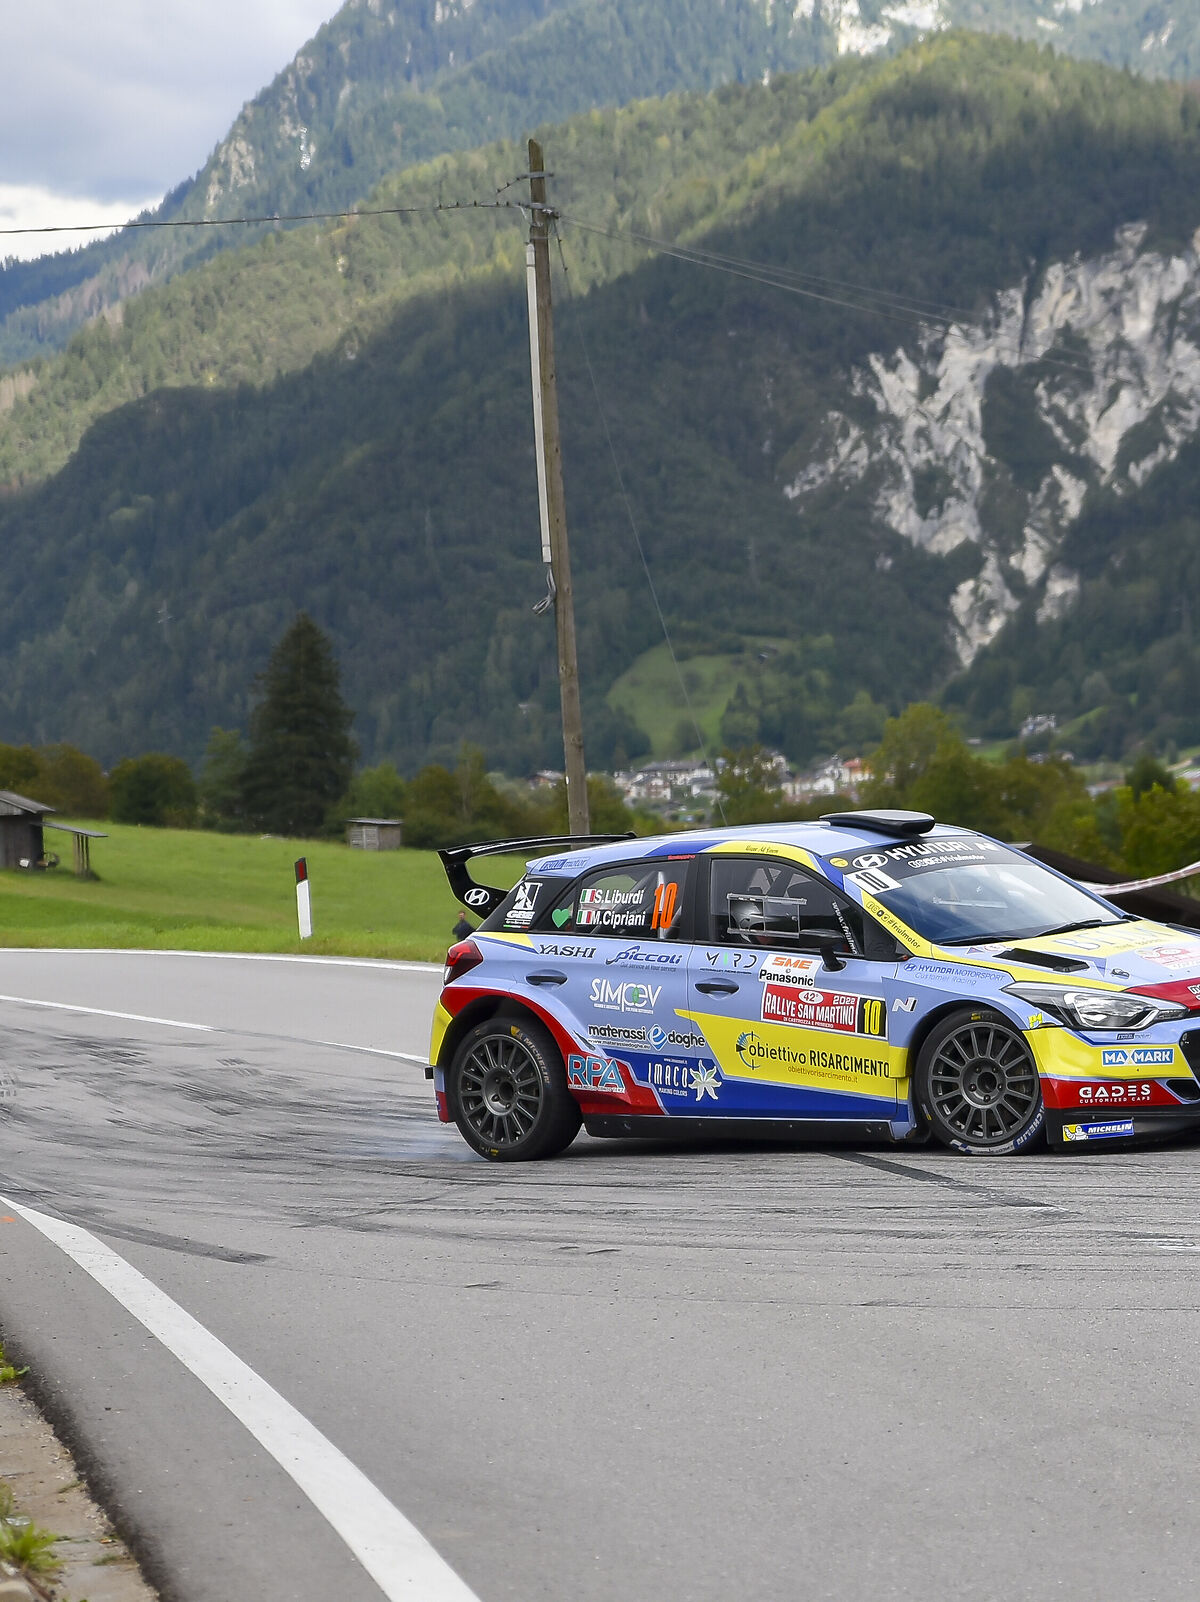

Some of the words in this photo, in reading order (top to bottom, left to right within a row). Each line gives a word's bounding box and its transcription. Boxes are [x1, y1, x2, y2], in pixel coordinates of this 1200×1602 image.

[885, 842, 973, 860] HYUNDAI
[855, 872, 889, 891] 10
[594, 889, 644, 904] S.Liburdi
[651, 882, 678, 930] 10
[591, 910, 646, 929] M.Cipriani
[540, 944, 597, 958] YASHI
[772, 957, 813, 970] SME
[919, 964, 954, 975] HYUNDAI
[954, 968, 1005, 981] MOTORSPORT
[759, 969, 814, 987] Panasonic
[765, 992, 796, 1018] RALLYE
[797, 1003, 815, 1020] SAN
[816, 1005, 855, 1026] MARTINO
[833, 995, 856, 1005] 2022
[863, 999, 881, 1035] 10
[588, 1024, 646, 1041] materassi
[667, 1031, 705, 1048] doghe
[749, 1042, 807, 1064] obiettivo
[809, 1050, 889, 1078] RISARCIMENTO
[1104, 1050, 1172, 1064] MAXMARK
[568, 1054, 626, 1092] RPA
[648, 1062, 688, 1088] IMACO
[787, 1066, 858, 1083] obiettivorisarcimento.it
[1087, 1123, 1133, 1134] MICHELIN
